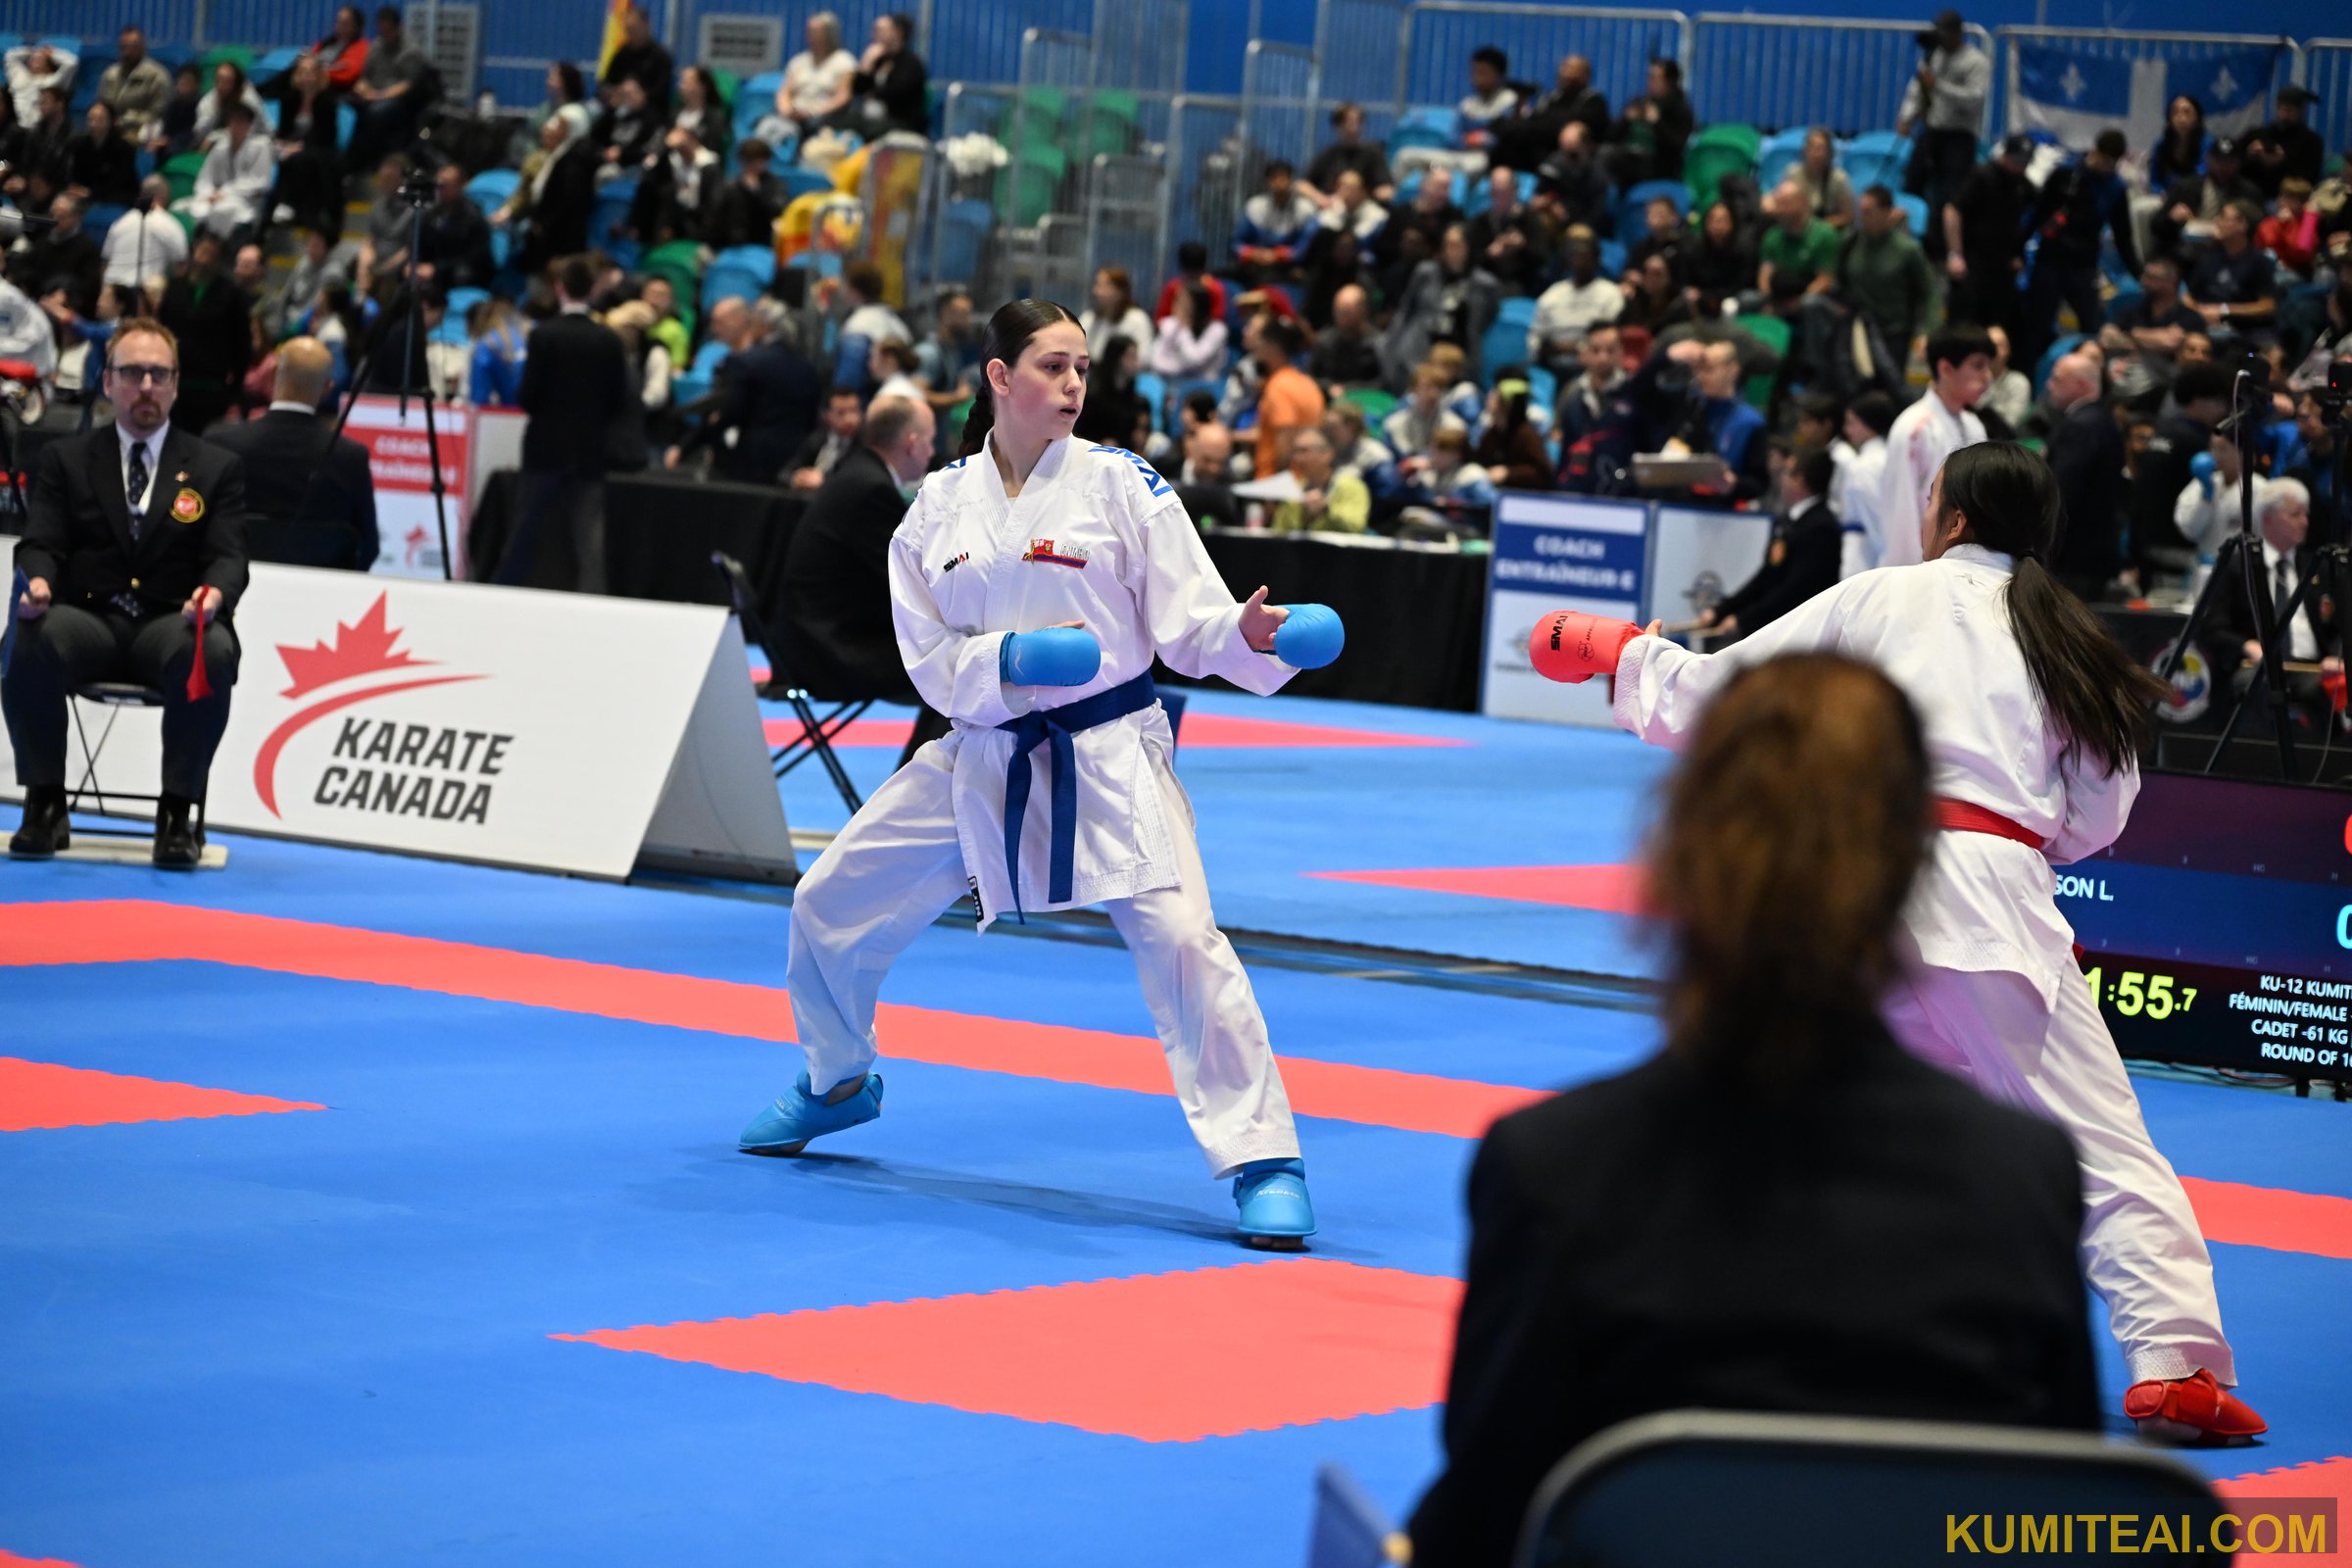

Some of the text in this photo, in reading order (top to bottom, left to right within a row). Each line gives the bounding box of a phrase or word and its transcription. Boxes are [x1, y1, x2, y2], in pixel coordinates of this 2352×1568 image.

[944, 552, 969, 572] SMAI
[1550, 615, 1568, 652] SMAI
[332, 717, 514, 775] KARATE
[314, 766, 492, 825] CANADA
[2099, 880, 2114, 902] L.
[2260, 975, 2352, 1000] KU-12 KUMIT
[2229, 991, 2347, 1022] FÉMININ/FEMALE
[2251, 1018, 2348, 1045] CADET -61 KG
[2261, 1042, 2315, 1063] ROUND
[2318, 1050, 2338, 1065] OF
